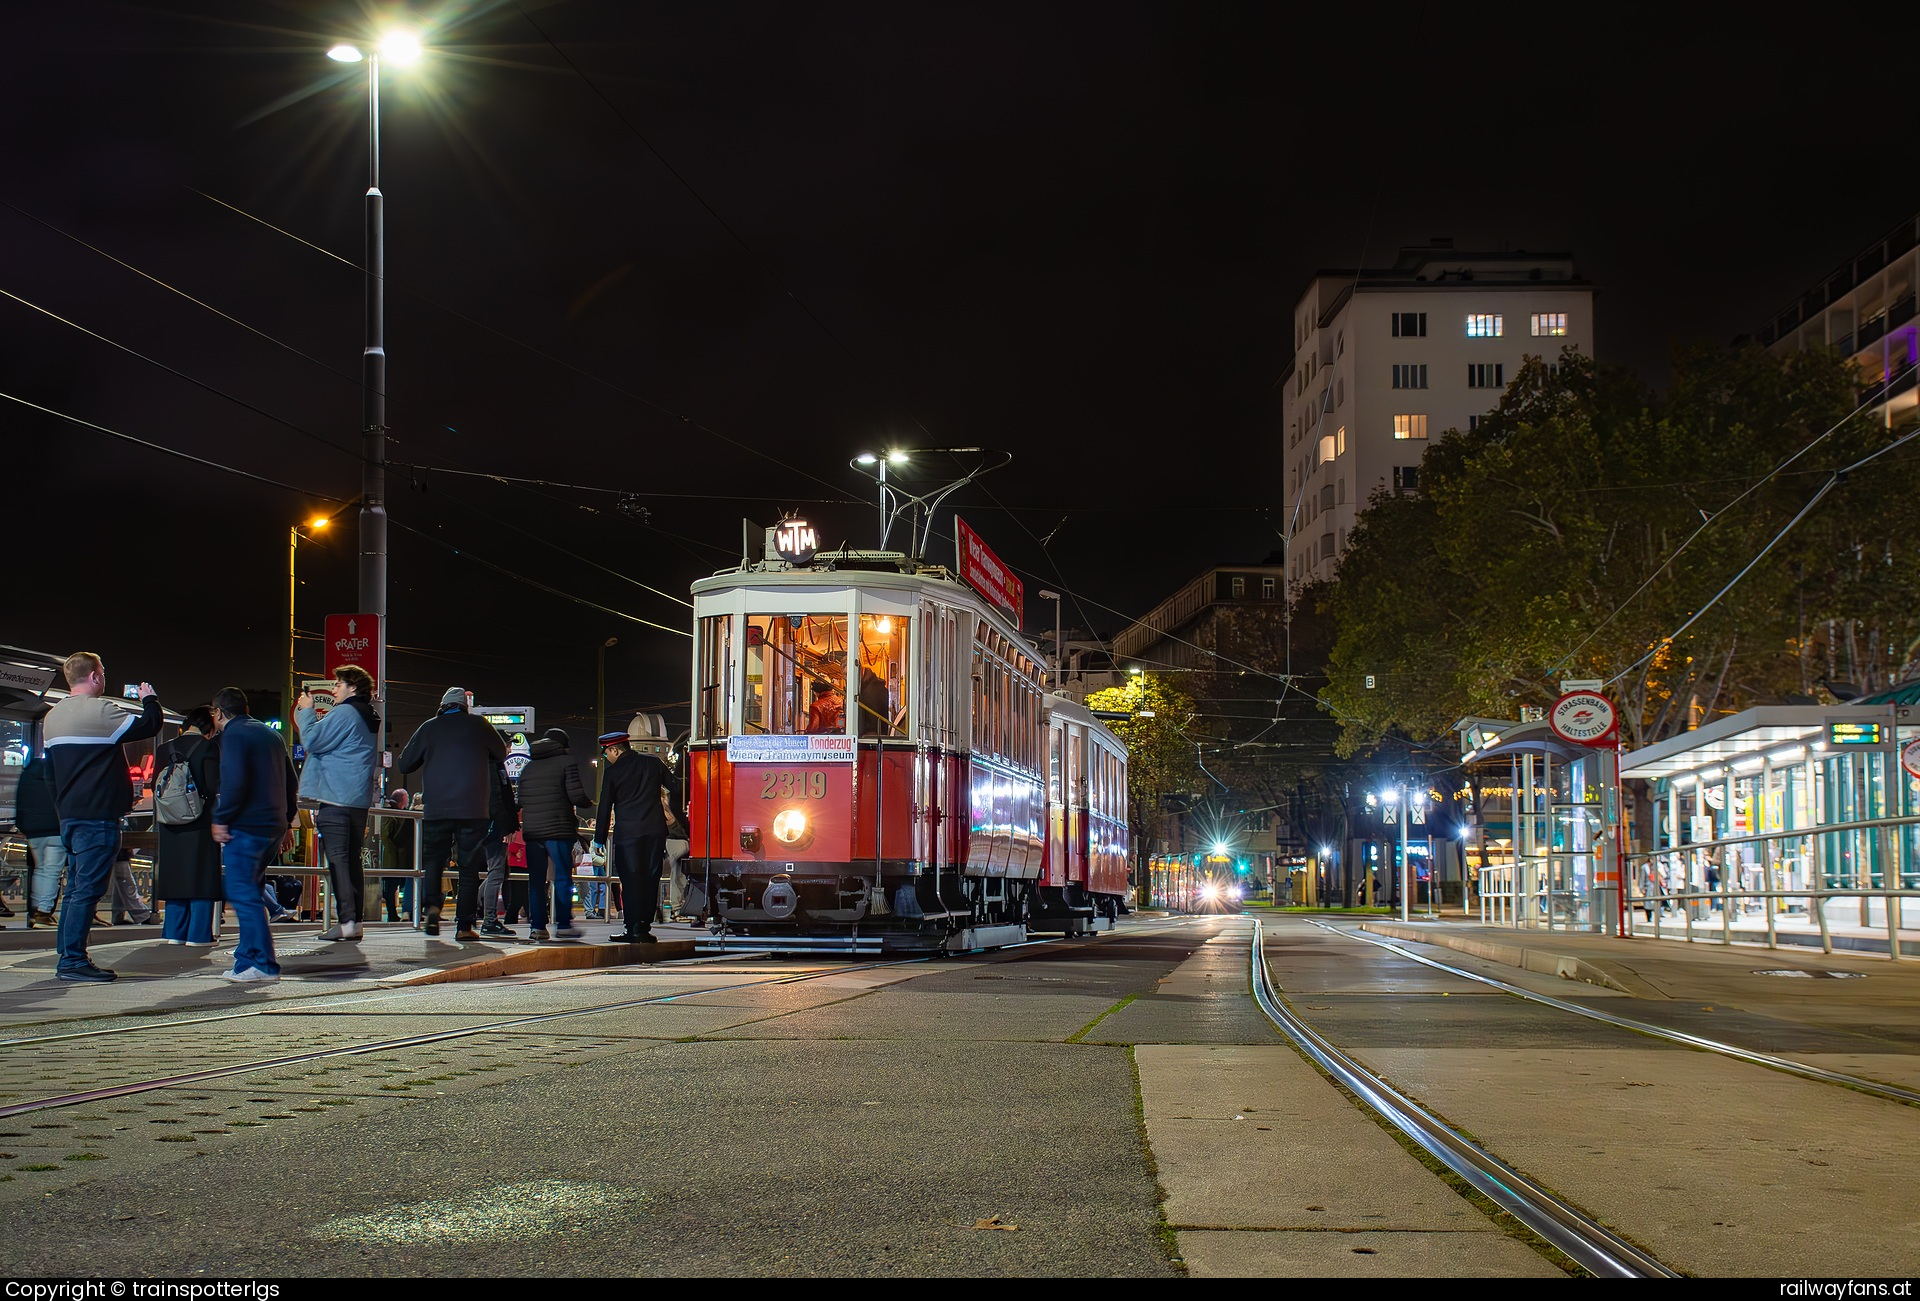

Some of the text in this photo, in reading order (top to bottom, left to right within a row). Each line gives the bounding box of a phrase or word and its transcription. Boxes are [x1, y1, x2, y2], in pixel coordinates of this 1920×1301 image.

[777, 521, 816, 555] WTM
[335, 637, 369, 651] PRATER
[1558, 697, 1609, 716] STRASSENBAHN
[1561, 721, 1607, 737] HALTESTELLE
[810, 736, 852, 752] Sonderzug
[729, 750, 854, 761] Wiener Tramwaymuseum
[761, 770, 827, 799] 2319
